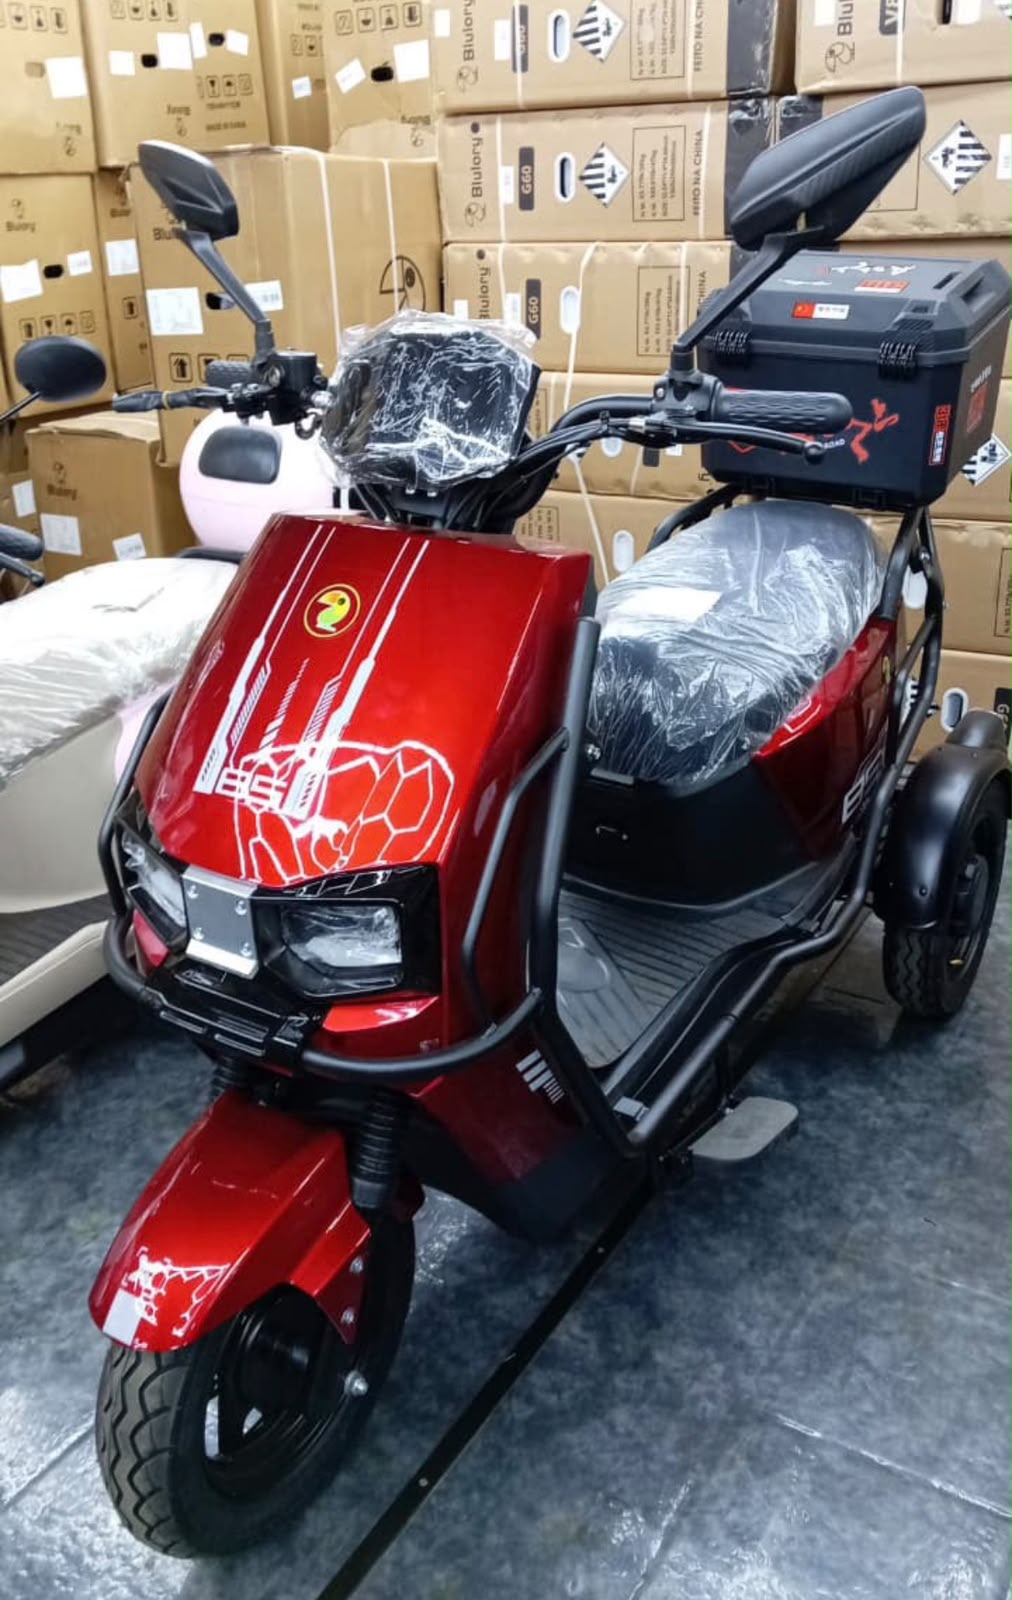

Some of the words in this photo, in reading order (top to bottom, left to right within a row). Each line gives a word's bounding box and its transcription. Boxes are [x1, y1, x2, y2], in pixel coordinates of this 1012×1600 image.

[693, 21, 703, 39] NA
[694, 129, 703, 166] CHINA
[470, 137, 484, 198] Blulory
[520, 164, 533, 195] G60
[693, 168, 702, 186] NA
[691, 187, 702, 216] FEITO
[527, 296, 540, 325] G60
